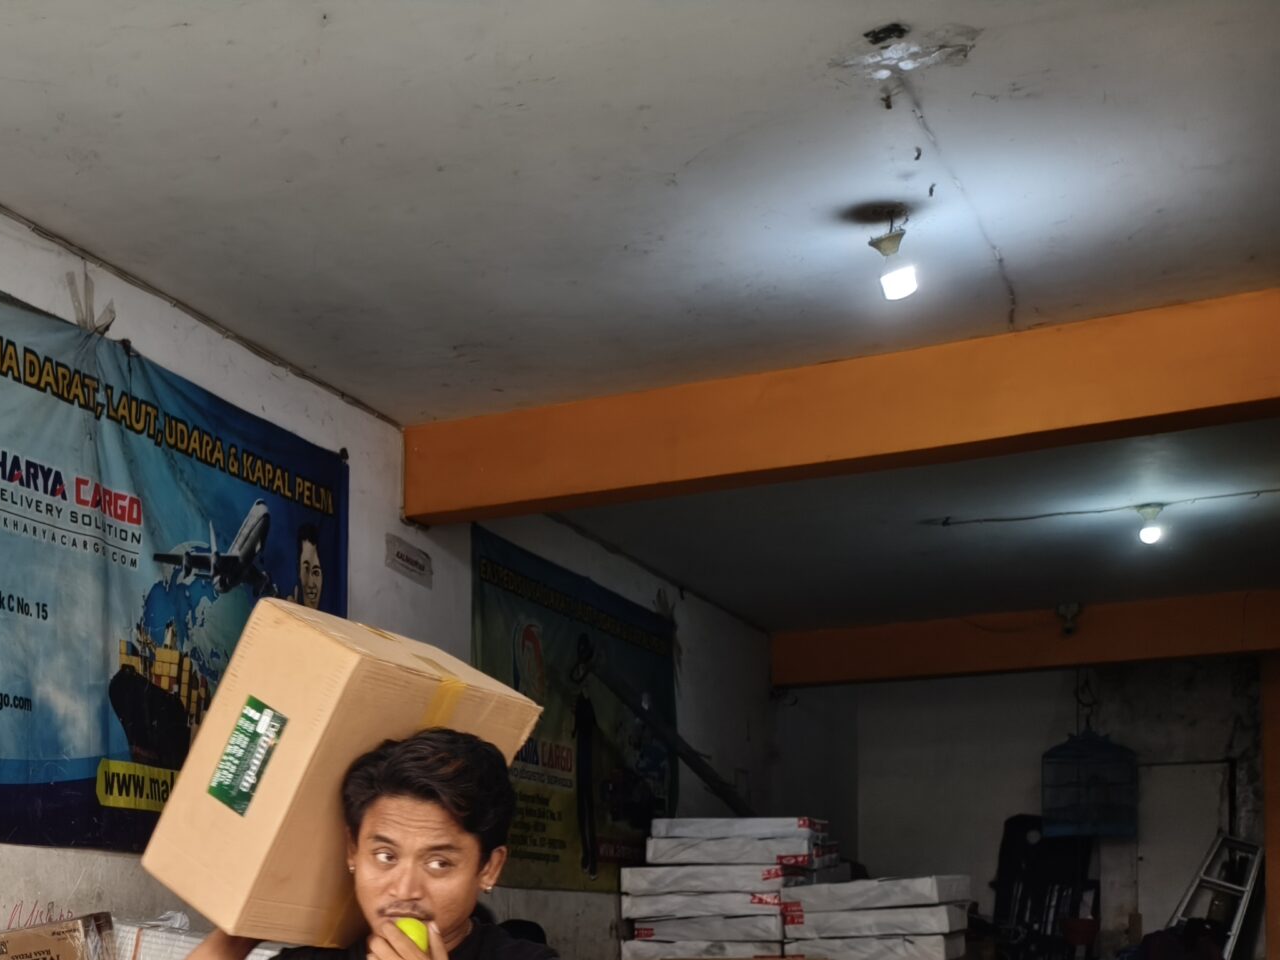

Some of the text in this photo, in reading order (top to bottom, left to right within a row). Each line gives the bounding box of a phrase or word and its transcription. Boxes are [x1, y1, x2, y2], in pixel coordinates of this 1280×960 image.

[23, 347, 106, 421] DARAT,
[106, 385, 163, 446] LAUT,
[163, 412, 225, 470] UDARA
[227, 444, 239, 476] &
[242, 452, 294, 501] KAPAL
[75, 477, 143, 526] CARGO
[70, 509, 142, 545] SOLUTION
[7, 594, 15, 612] C
[17, 598, 33, 618] No.
[35, 602, 49, 621] 15
